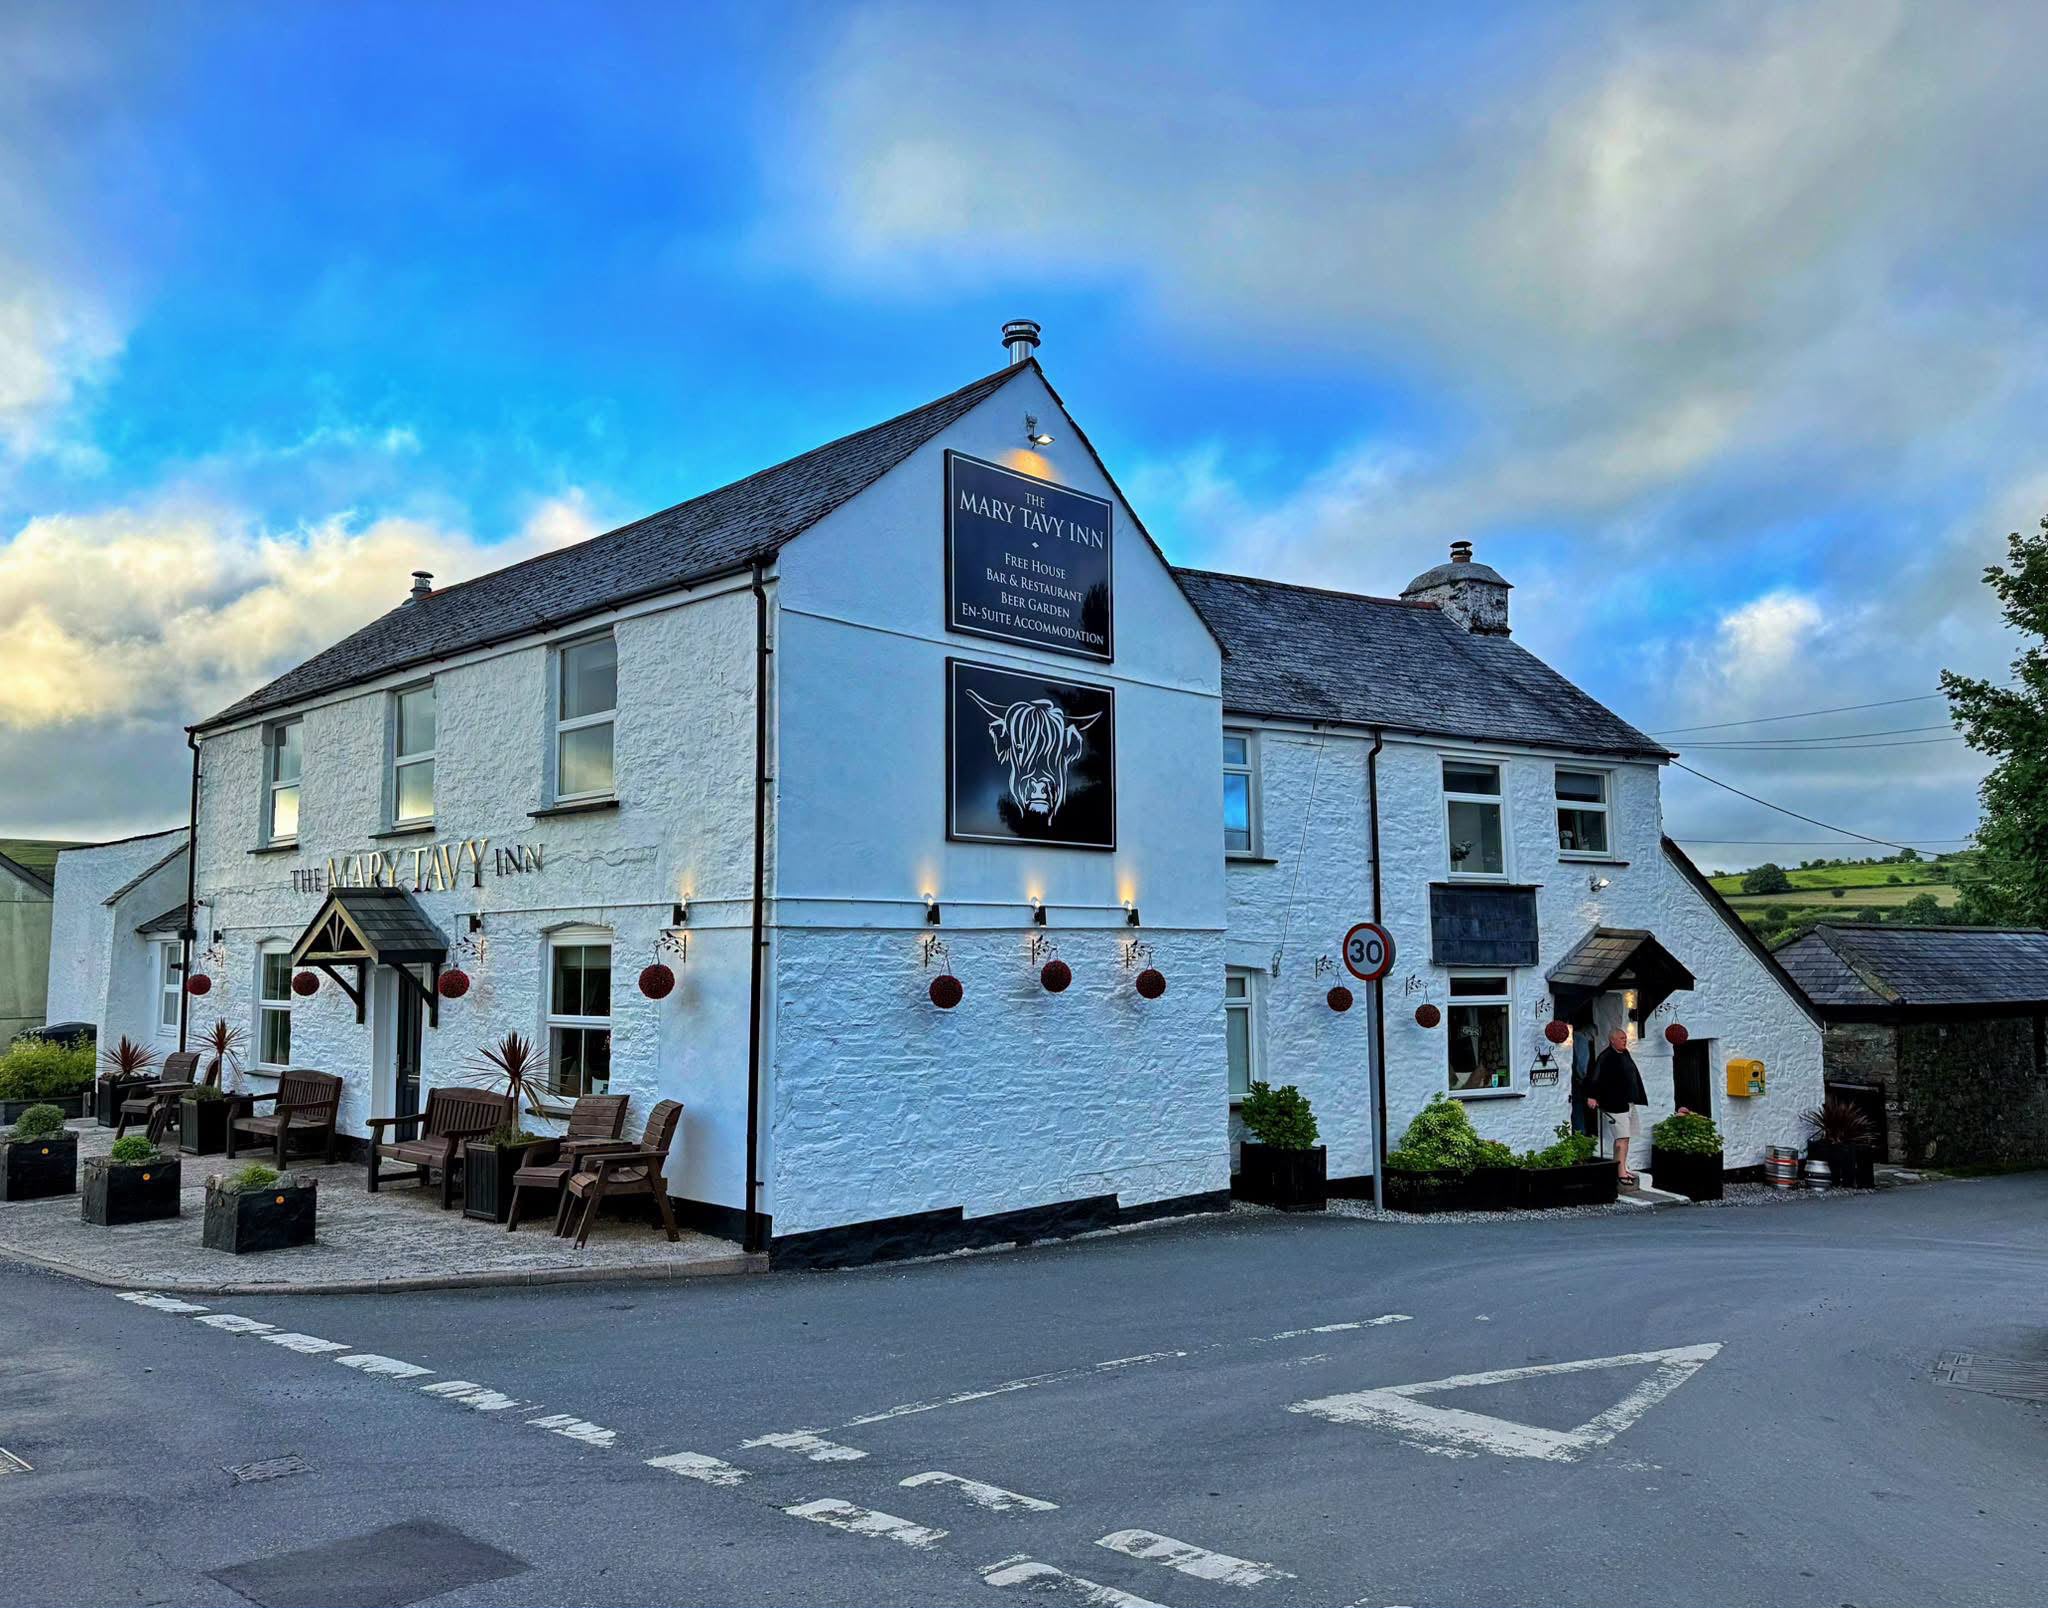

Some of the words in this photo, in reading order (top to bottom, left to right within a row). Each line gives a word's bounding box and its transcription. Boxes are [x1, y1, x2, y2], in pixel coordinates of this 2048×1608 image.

[1024, 492, 1045, 508] THE
[960, 489, 1016, 524] MARY
[1020, 507, 1065, 538] TAVY
[1070, 522, 1104, 550] INN
[1005, 552, 1029, 570] FREE
[1032, 559, 1067, 580] HOUSE
[986, 567, 1007, 585] BAR
[1009, 574, 1019, 588] &
[1021, 576, 1083, 603] RESTAURANT
[1001, 591, 1026, 609] BEER
[1028, 598, 1070, 618] GARDEN
[1014, 615, 1104, 646] ACCOMMODATION
[290, 868, 322, 893] THE
[327, 847, 403, 891] MARY
[410, 838, 488, 893] TAVY
[495, 842, 545, 878] INN
[1350, 938, 1383, 964] 30
